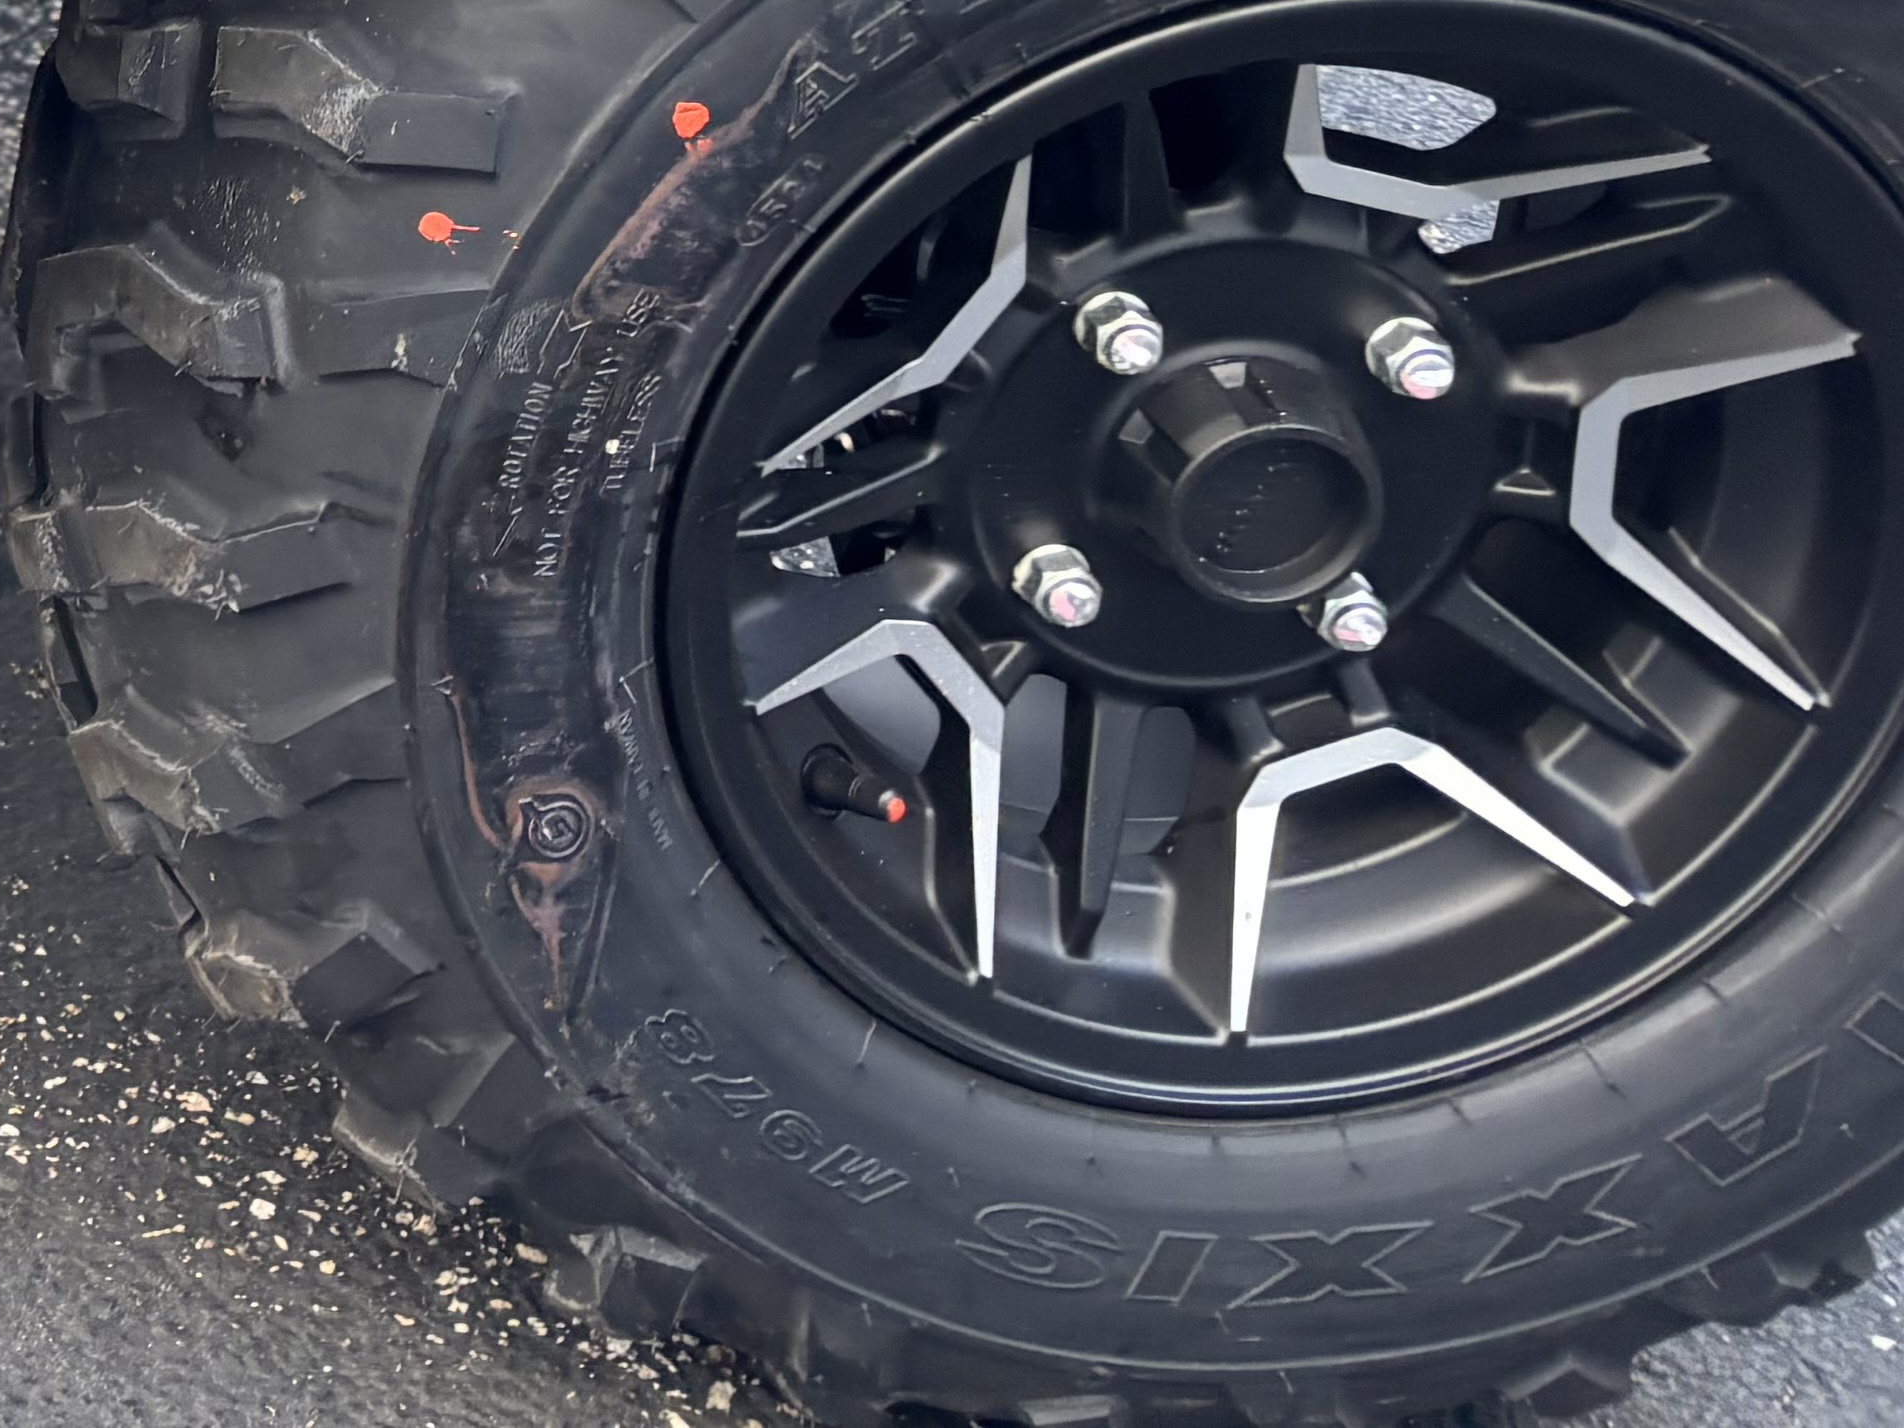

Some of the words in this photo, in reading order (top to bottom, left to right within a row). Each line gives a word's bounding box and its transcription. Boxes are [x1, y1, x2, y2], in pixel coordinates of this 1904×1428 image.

[499, 380, 553, 489] ROTATION
[563, 346, 625, 454] HIGHWAY
[547, 465, 580, 515] FOR
[533, 527, 562, 577] NOT
[644, 1007, 912, 1206] M978
[955, 992, 1904, 1310] AXXIS
